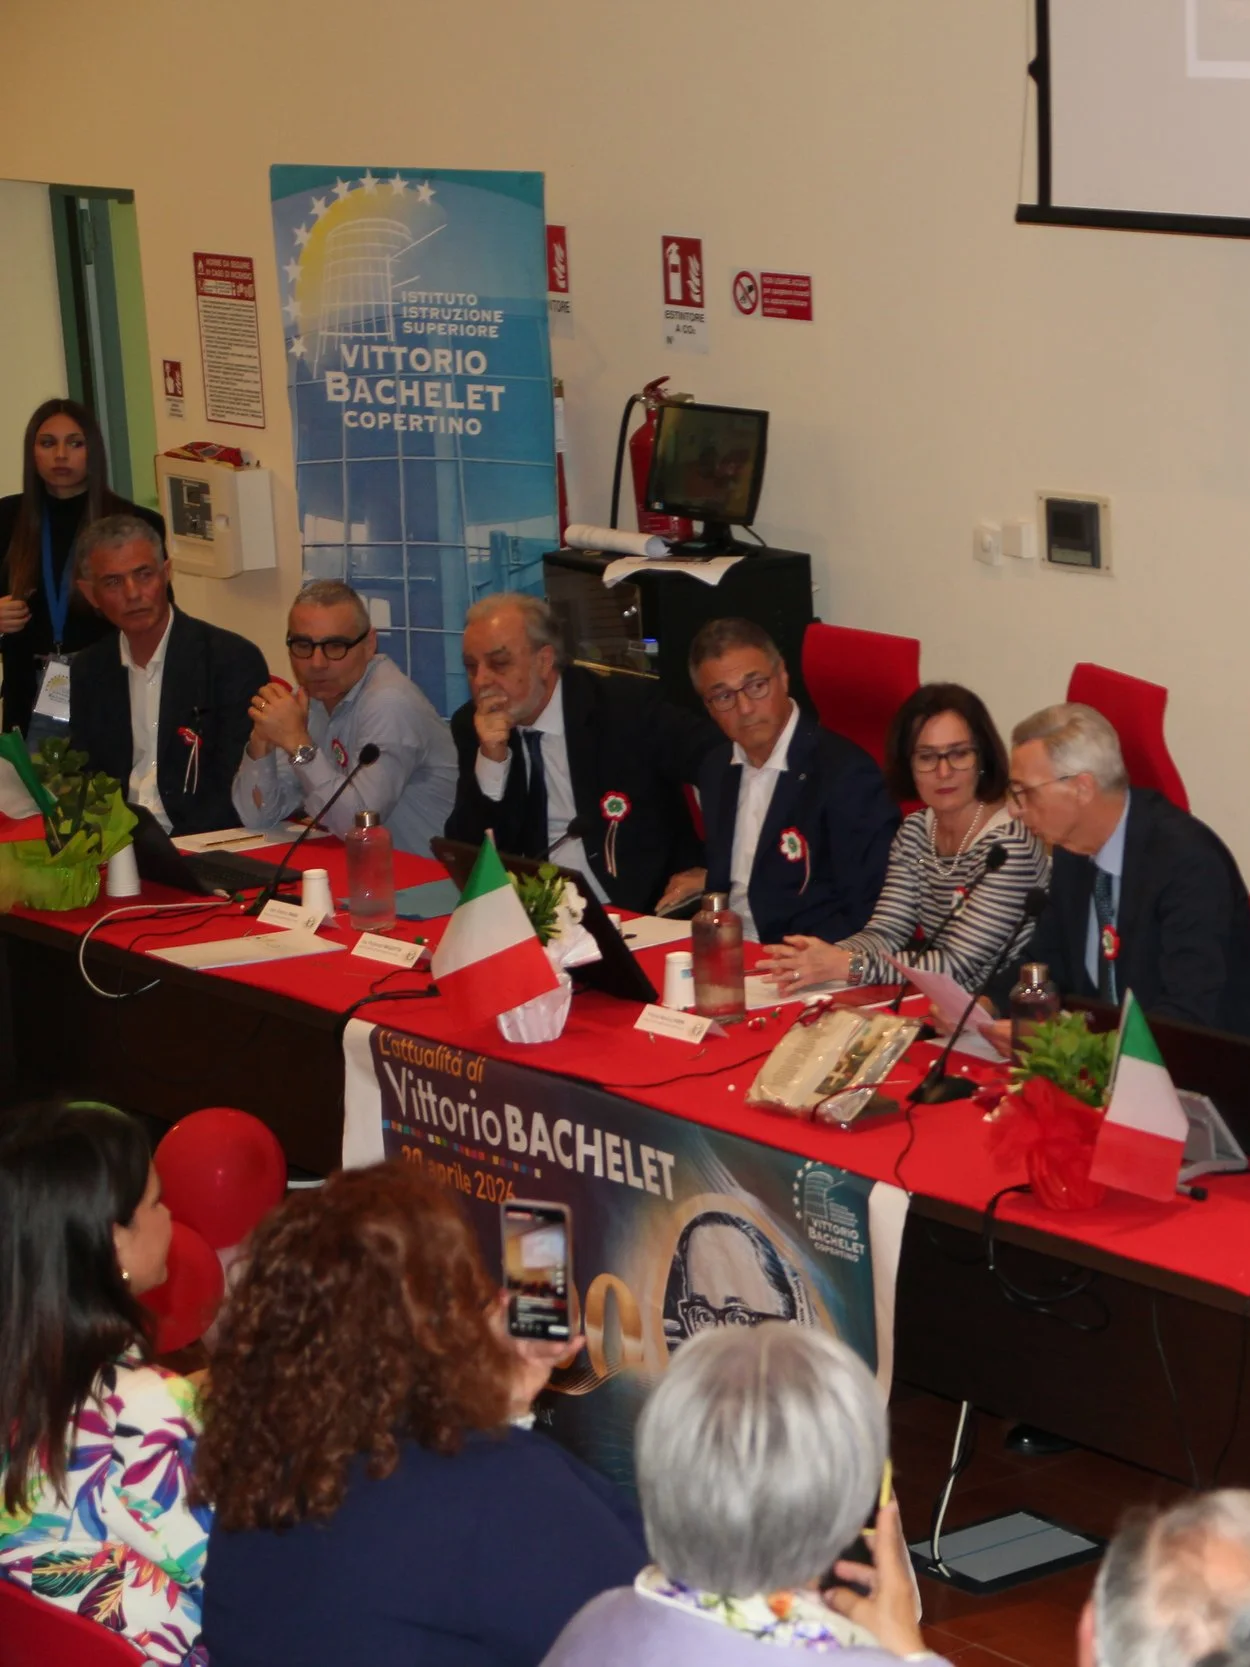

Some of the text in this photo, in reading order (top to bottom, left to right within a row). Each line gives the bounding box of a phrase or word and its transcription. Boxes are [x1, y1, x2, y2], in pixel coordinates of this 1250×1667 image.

[402, 291, 478, 306] ISTITUTO
[402, 306, 504, 323] ISTRUZIONE
[664, 310, 705, 323] ESTINTORE
[402, 321, 499, 338] SUPERIORE
[340, 343, 488, 375] VITTORIO
[325, 370, 506, 412] BACHELET
[343, 410, 482, 435] COPERTINO
[467, 1056, 486, 1083] di
[383, 1061, 675, 1201] Vittorio BACHELET
[807, 1226, 865, 1255] BACHELET
[811, 1218, 859, 1240] VITTORIO
